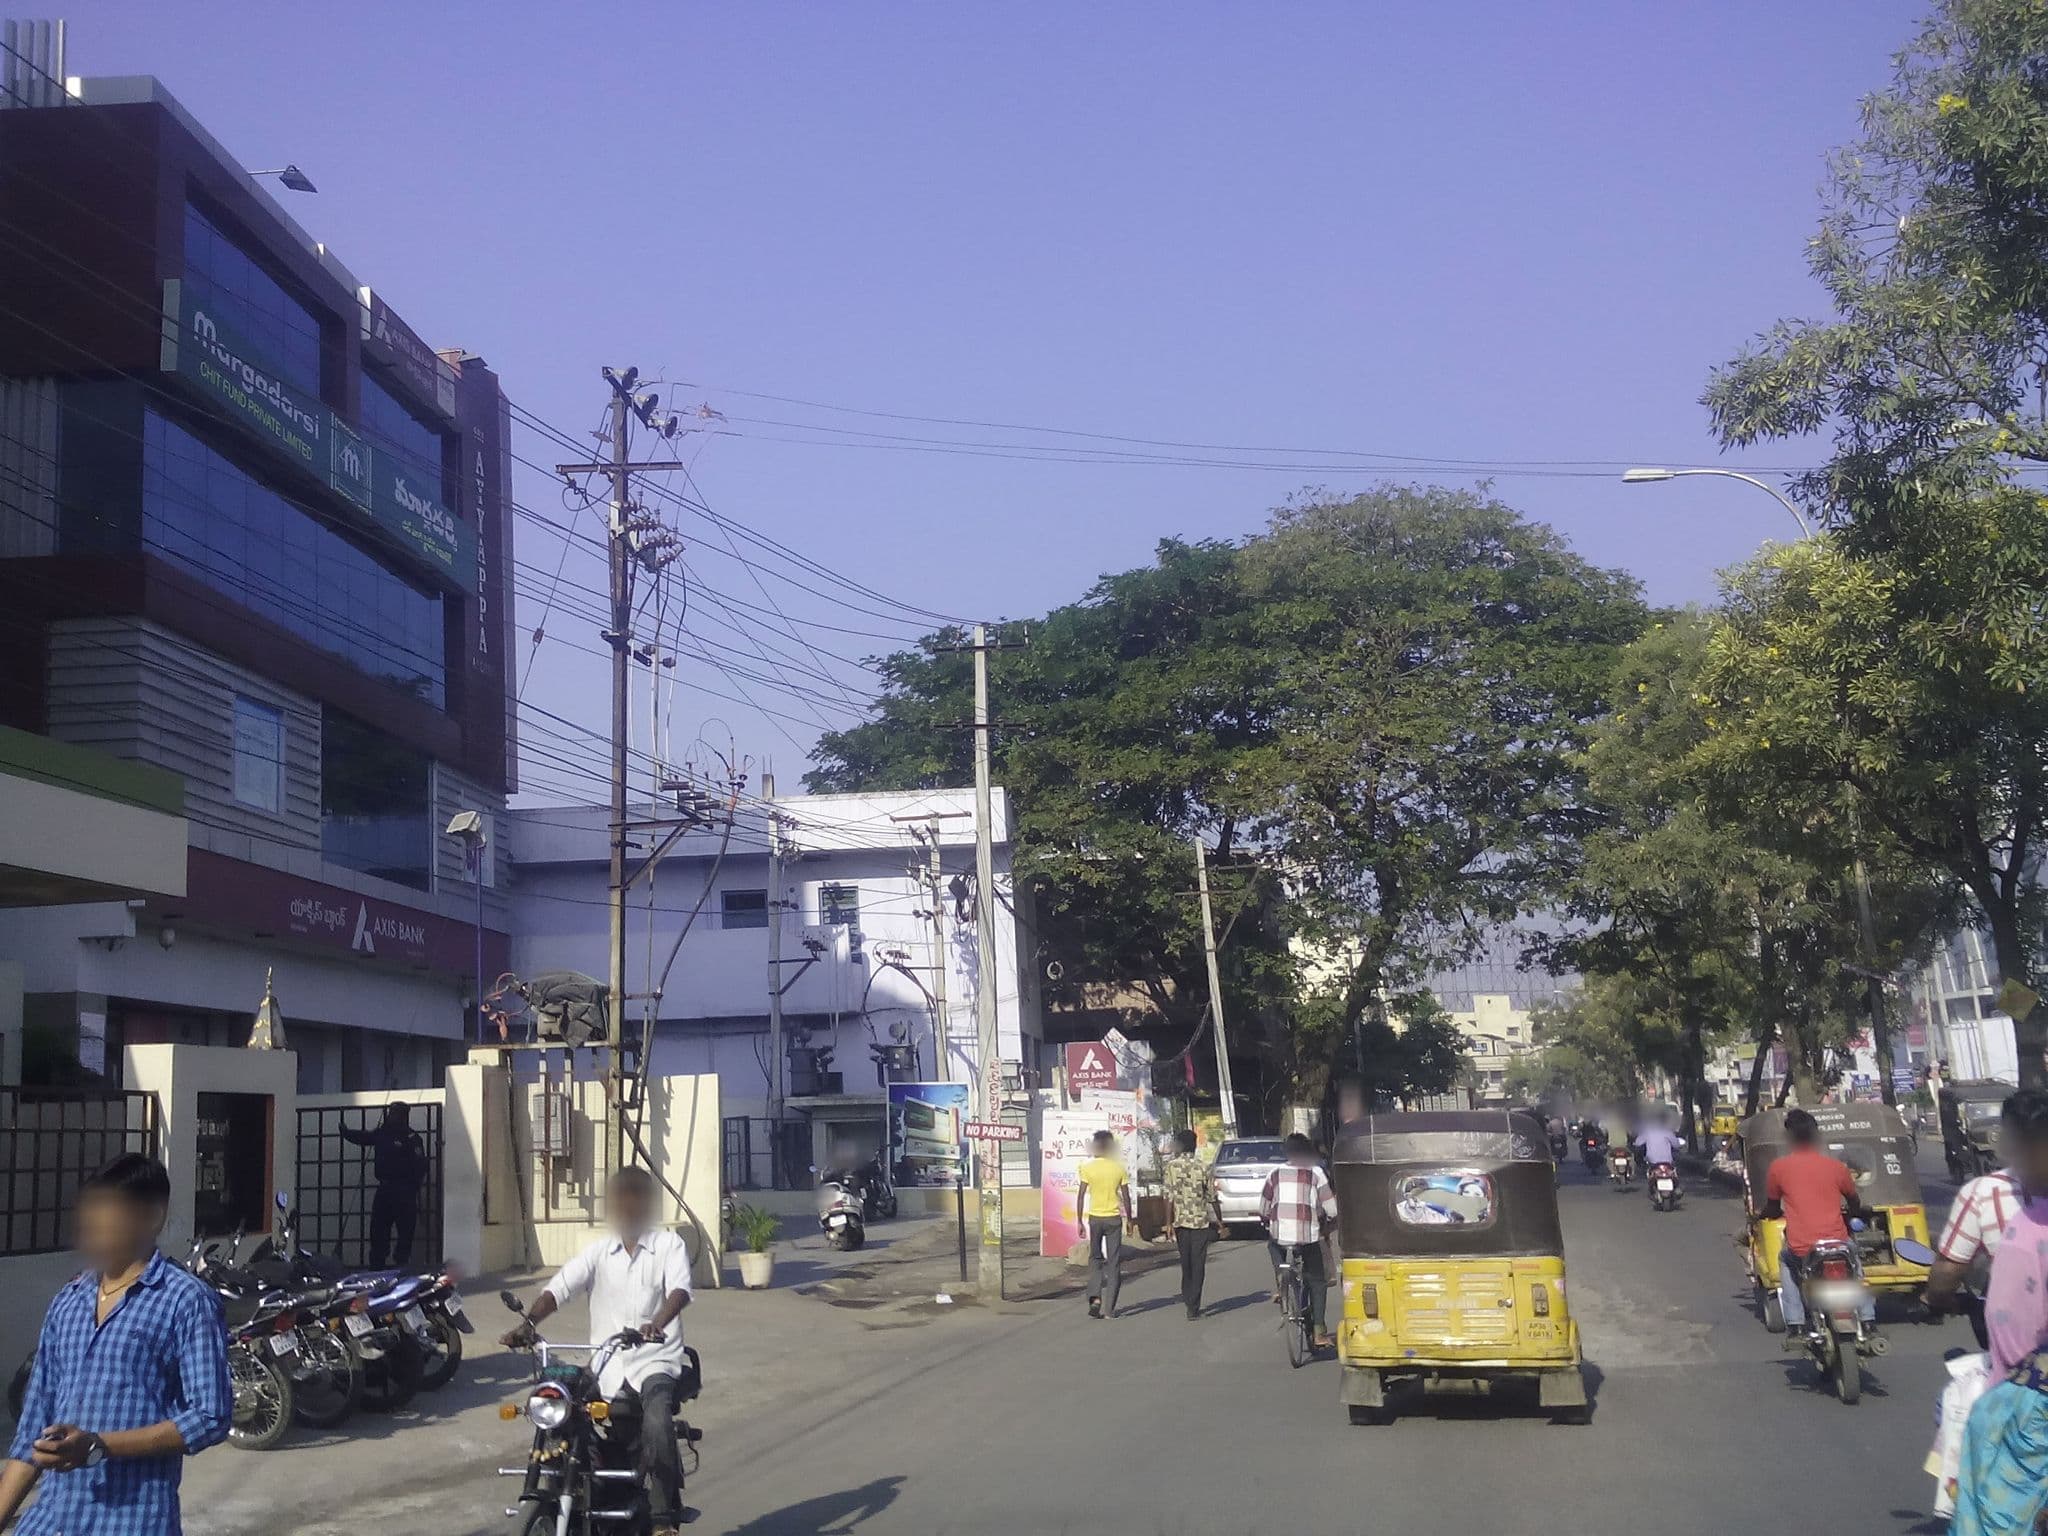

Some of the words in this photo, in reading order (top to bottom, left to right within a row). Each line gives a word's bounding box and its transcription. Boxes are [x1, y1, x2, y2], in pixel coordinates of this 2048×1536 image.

[200, 361, 221, 390] CHIT
[223, 379, 247, 408] FUND
[248, 403, 281, 437] PRIVATE
[283, 427, 313, 461] LIMITED
[374, 916, 397, 938] AXIS
[399, 921, 425, 945] BANK
[1091, 1071, 1112, 1079] BANK
[966, 1124, 980, 1136] NO
[982, 1125, 1020, 1139] PARKING
[1886, 1163, 1902, 1175] 02
